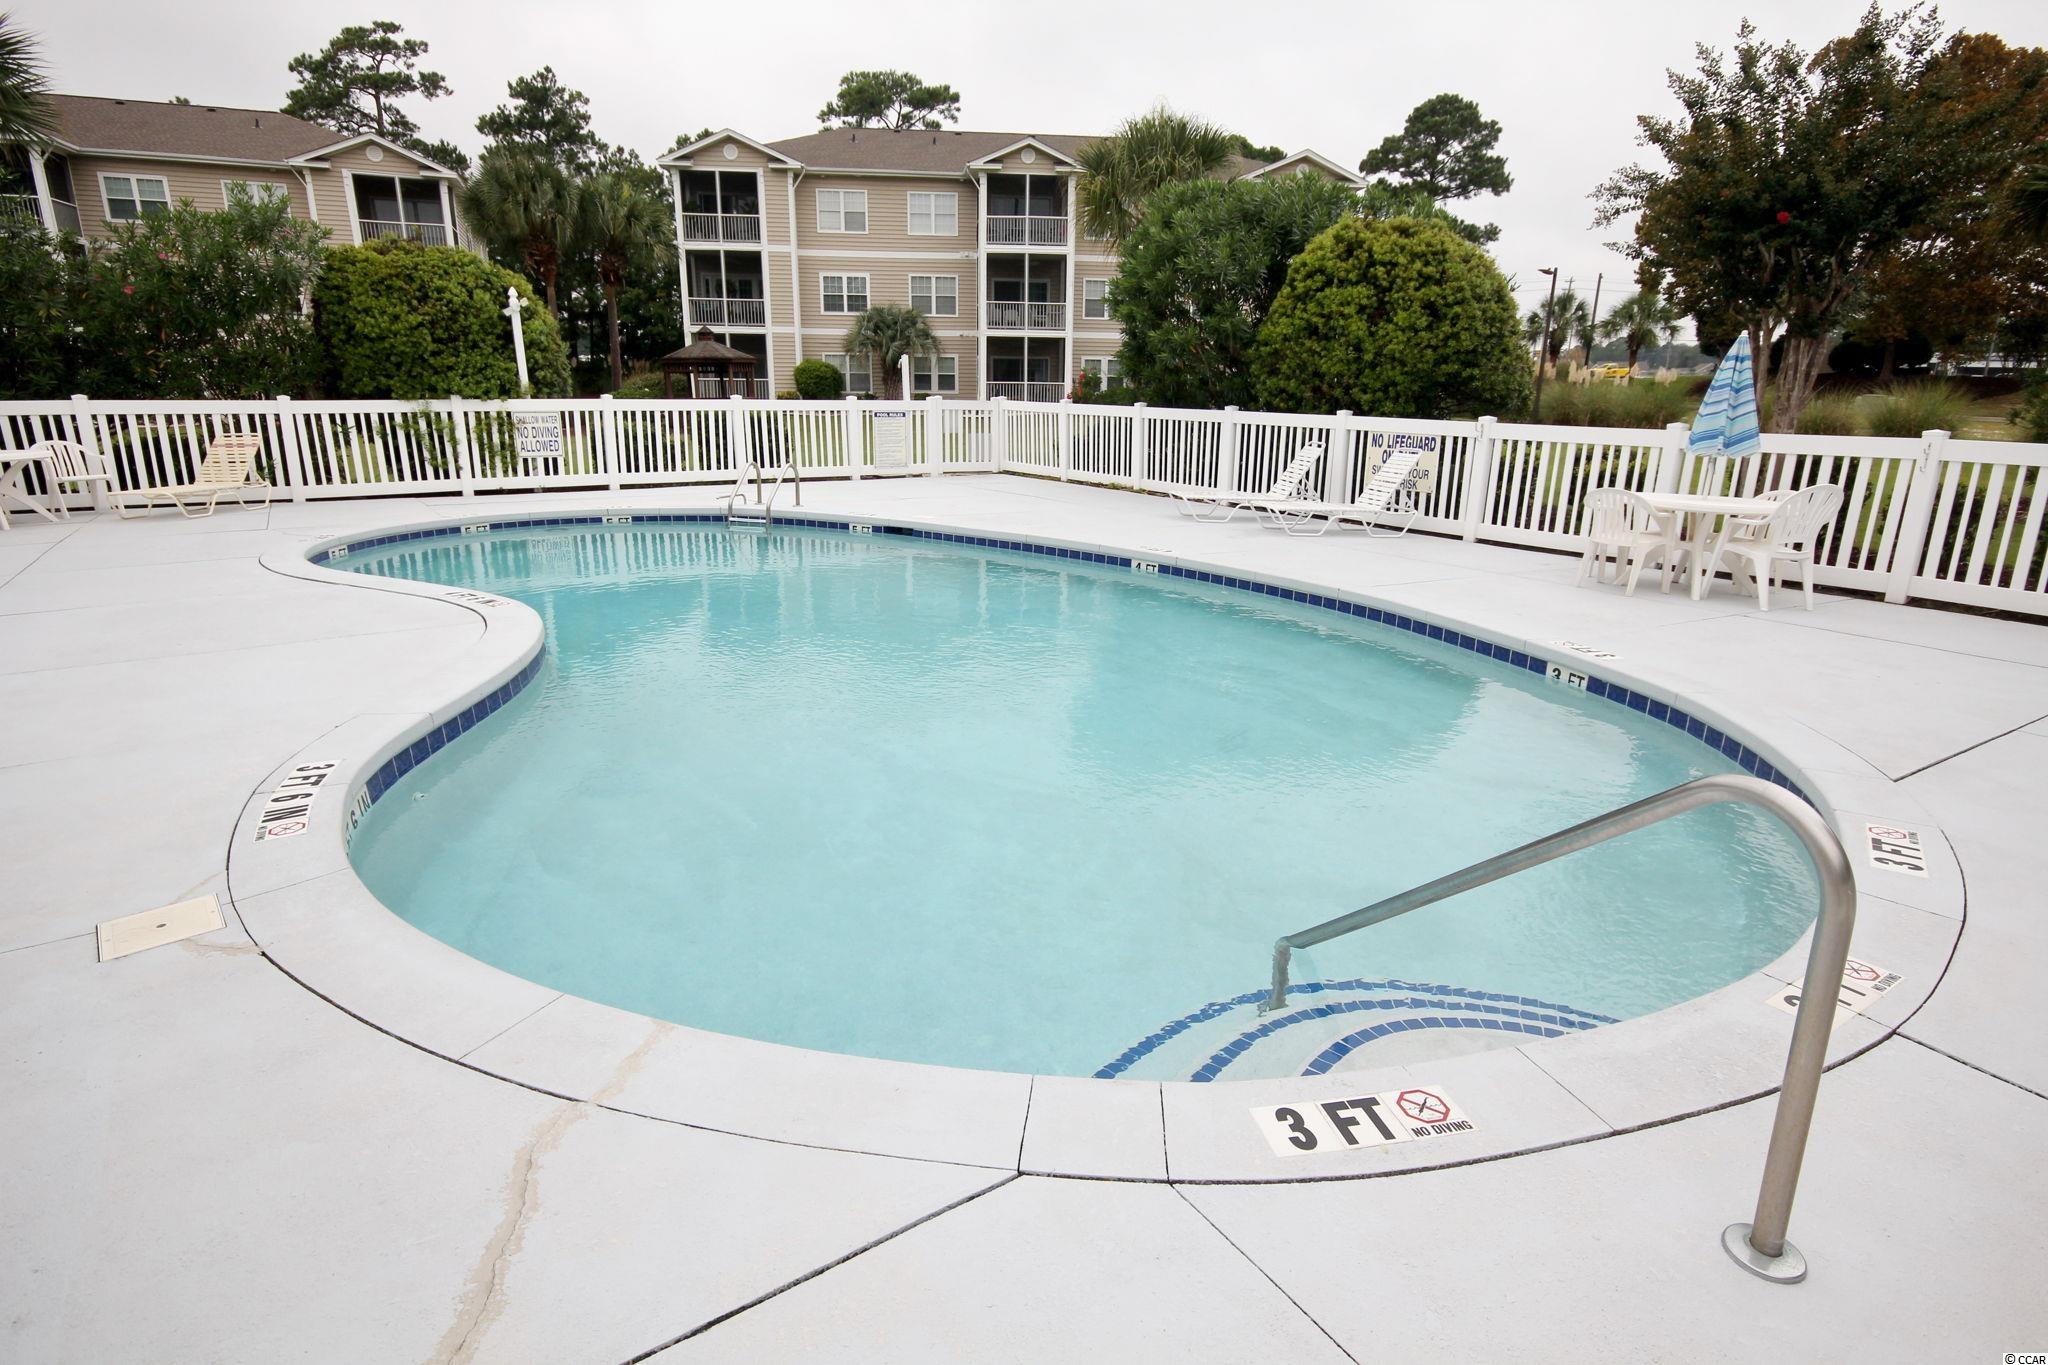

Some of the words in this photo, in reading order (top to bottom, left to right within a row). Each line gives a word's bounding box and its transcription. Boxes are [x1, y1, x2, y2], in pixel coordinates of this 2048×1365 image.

[540, 415, 558, 424] WATER
[516, 426, 529, 439] NO
[531, 426, 559, 439] DIVING
[521, 440, 560, 452] ALLOWED
[1371, 433, 1384, 448] NO
[1387, 434, 1437, 452] LIFEGUARD
[1568, 672, 1586, 688] FT
[296, 763, 335, 772] 3
[280, 773, 328, 788] FT
[270, 793, 314, 803] 6
[261, 804, 309, 824] IN
[1871, 837, 1923, 860] FT
[1873, 857, 1925, 872] 3
[1275, 1107, 1318, 1151] 3
[1320, 1096, 1397, 1145] FT
[1411, 1126, 1432, 1138] NO
[1430, 1120, 1474, 1135] DIVING
